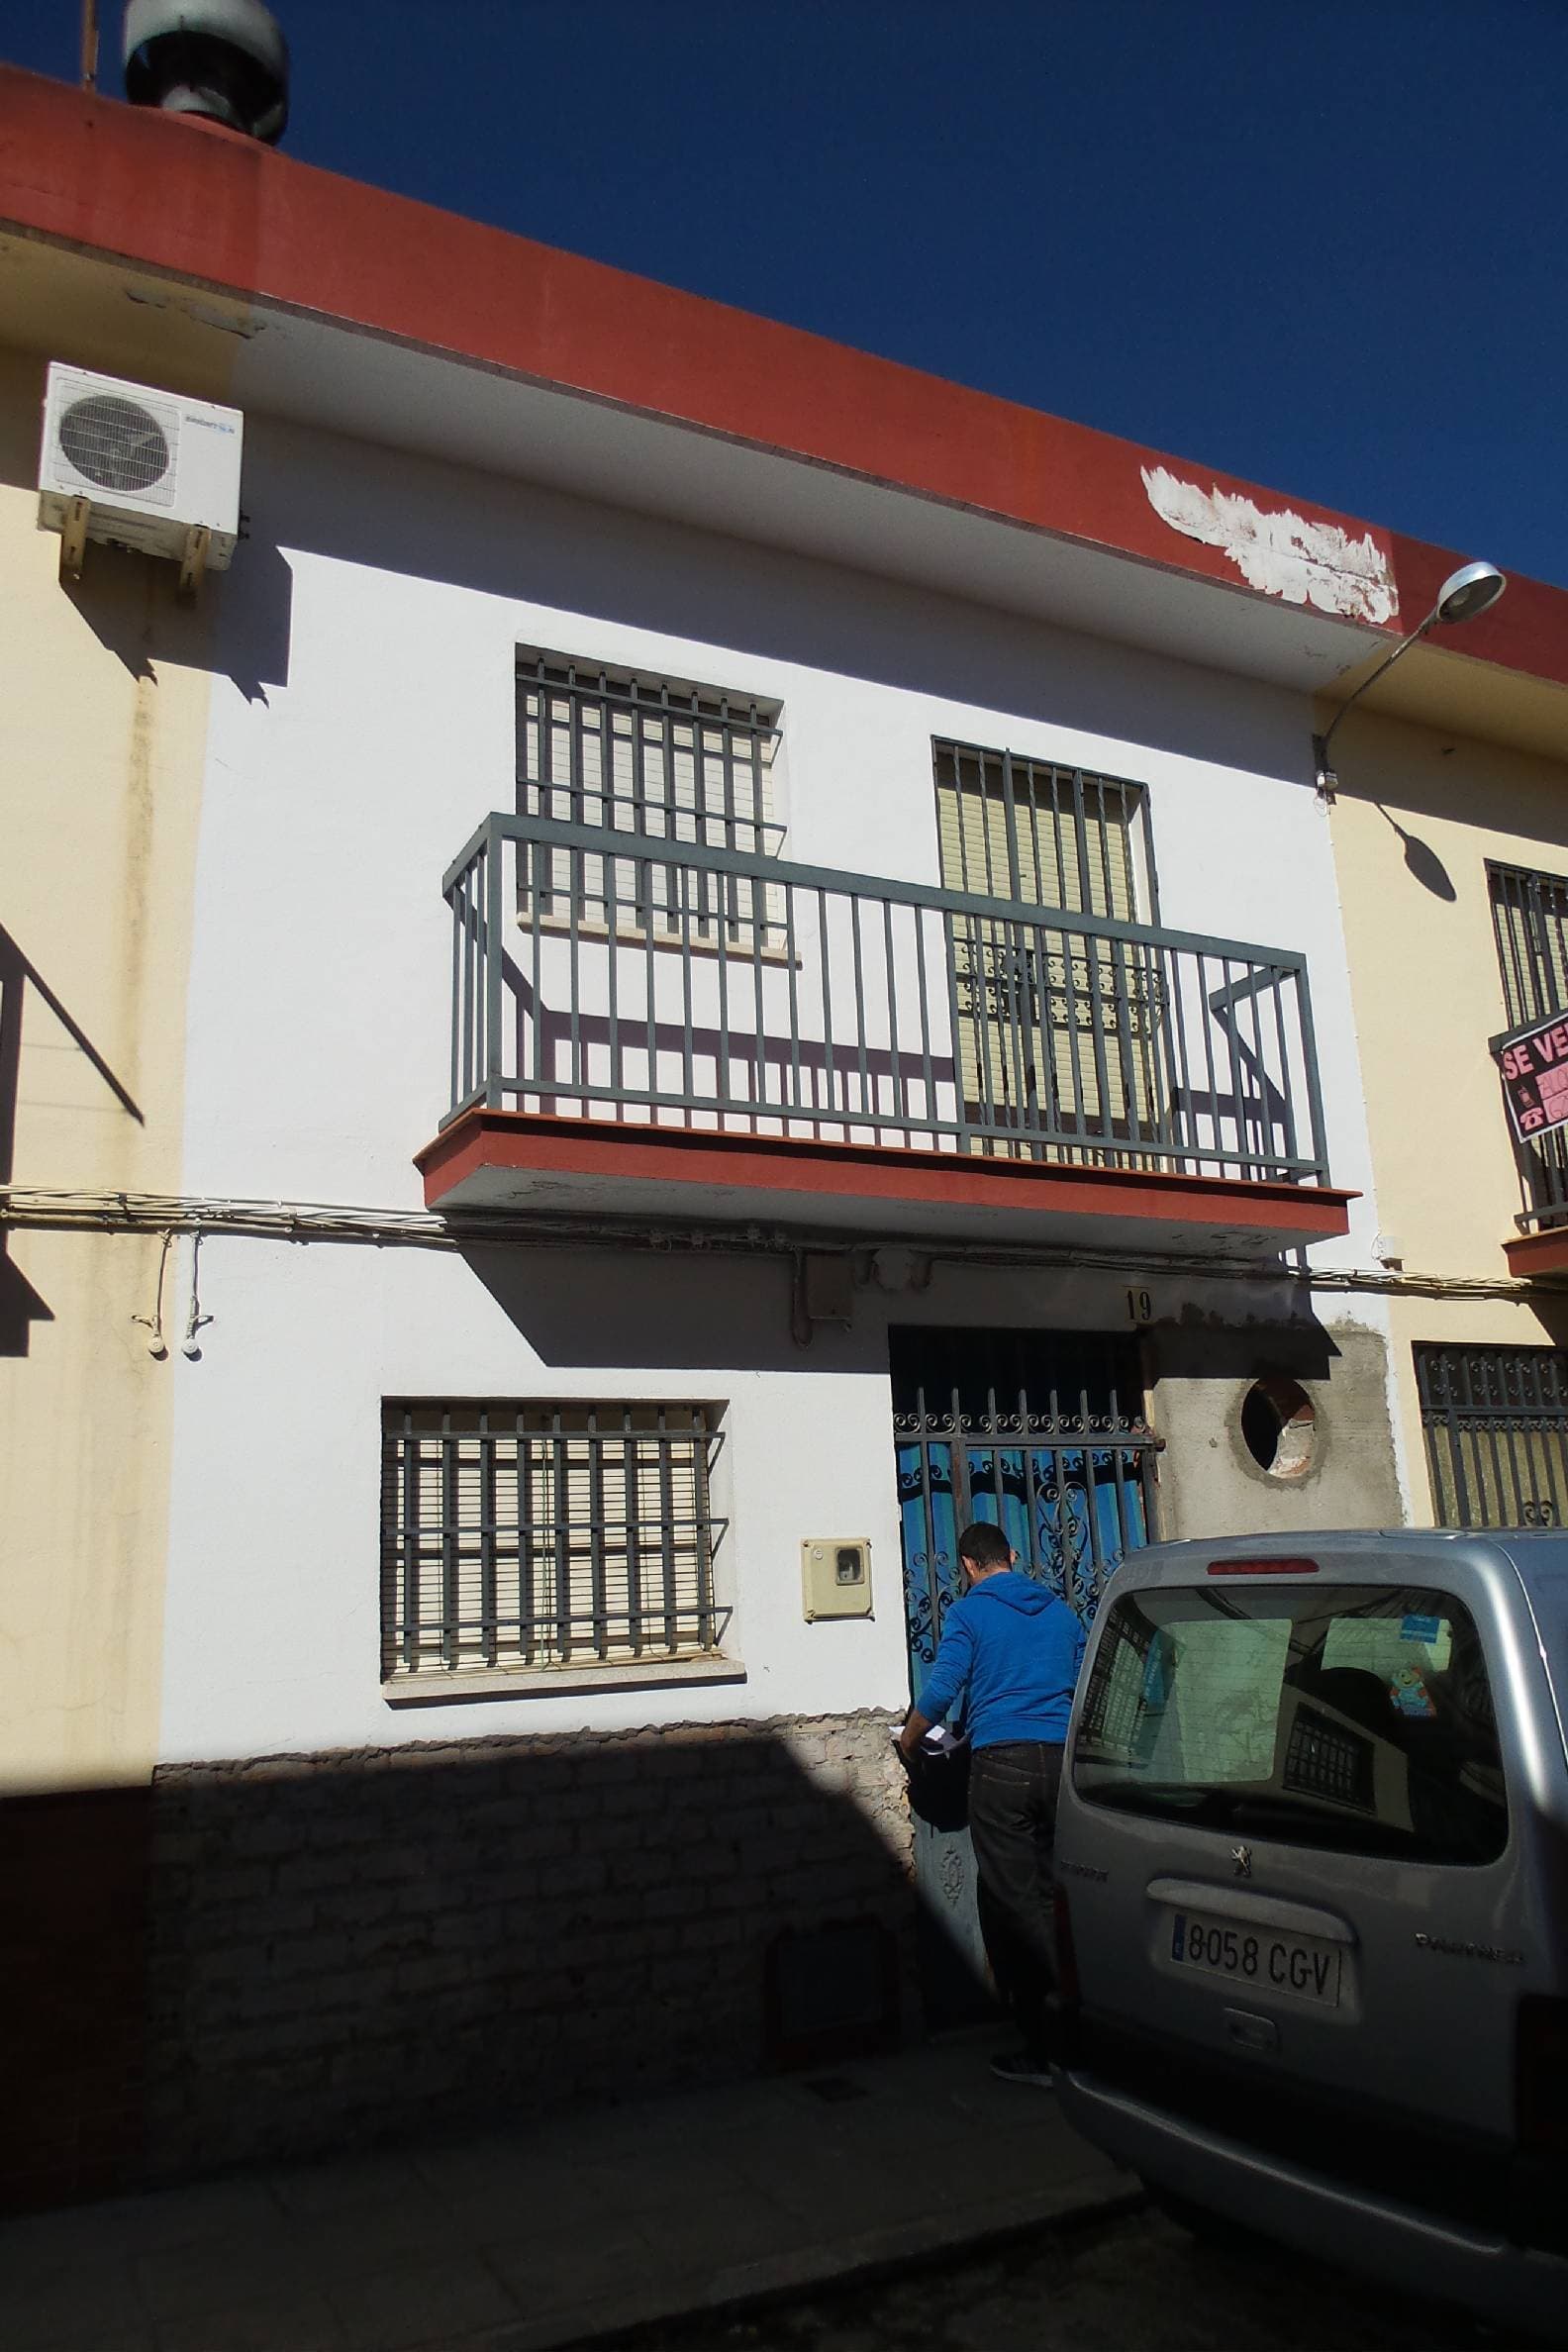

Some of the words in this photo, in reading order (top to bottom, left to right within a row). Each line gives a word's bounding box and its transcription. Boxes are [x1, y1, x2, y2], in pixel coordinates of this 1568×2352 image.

[1504, 1044, 1534, 1080] SE
[1532, 1023, 1568, 1062] VE
[1127, 1290, 1151, 1321] 19
[1189, 1923, 1258, 1976] 8058
[1269, 1943, 1330, 1995] CGV
